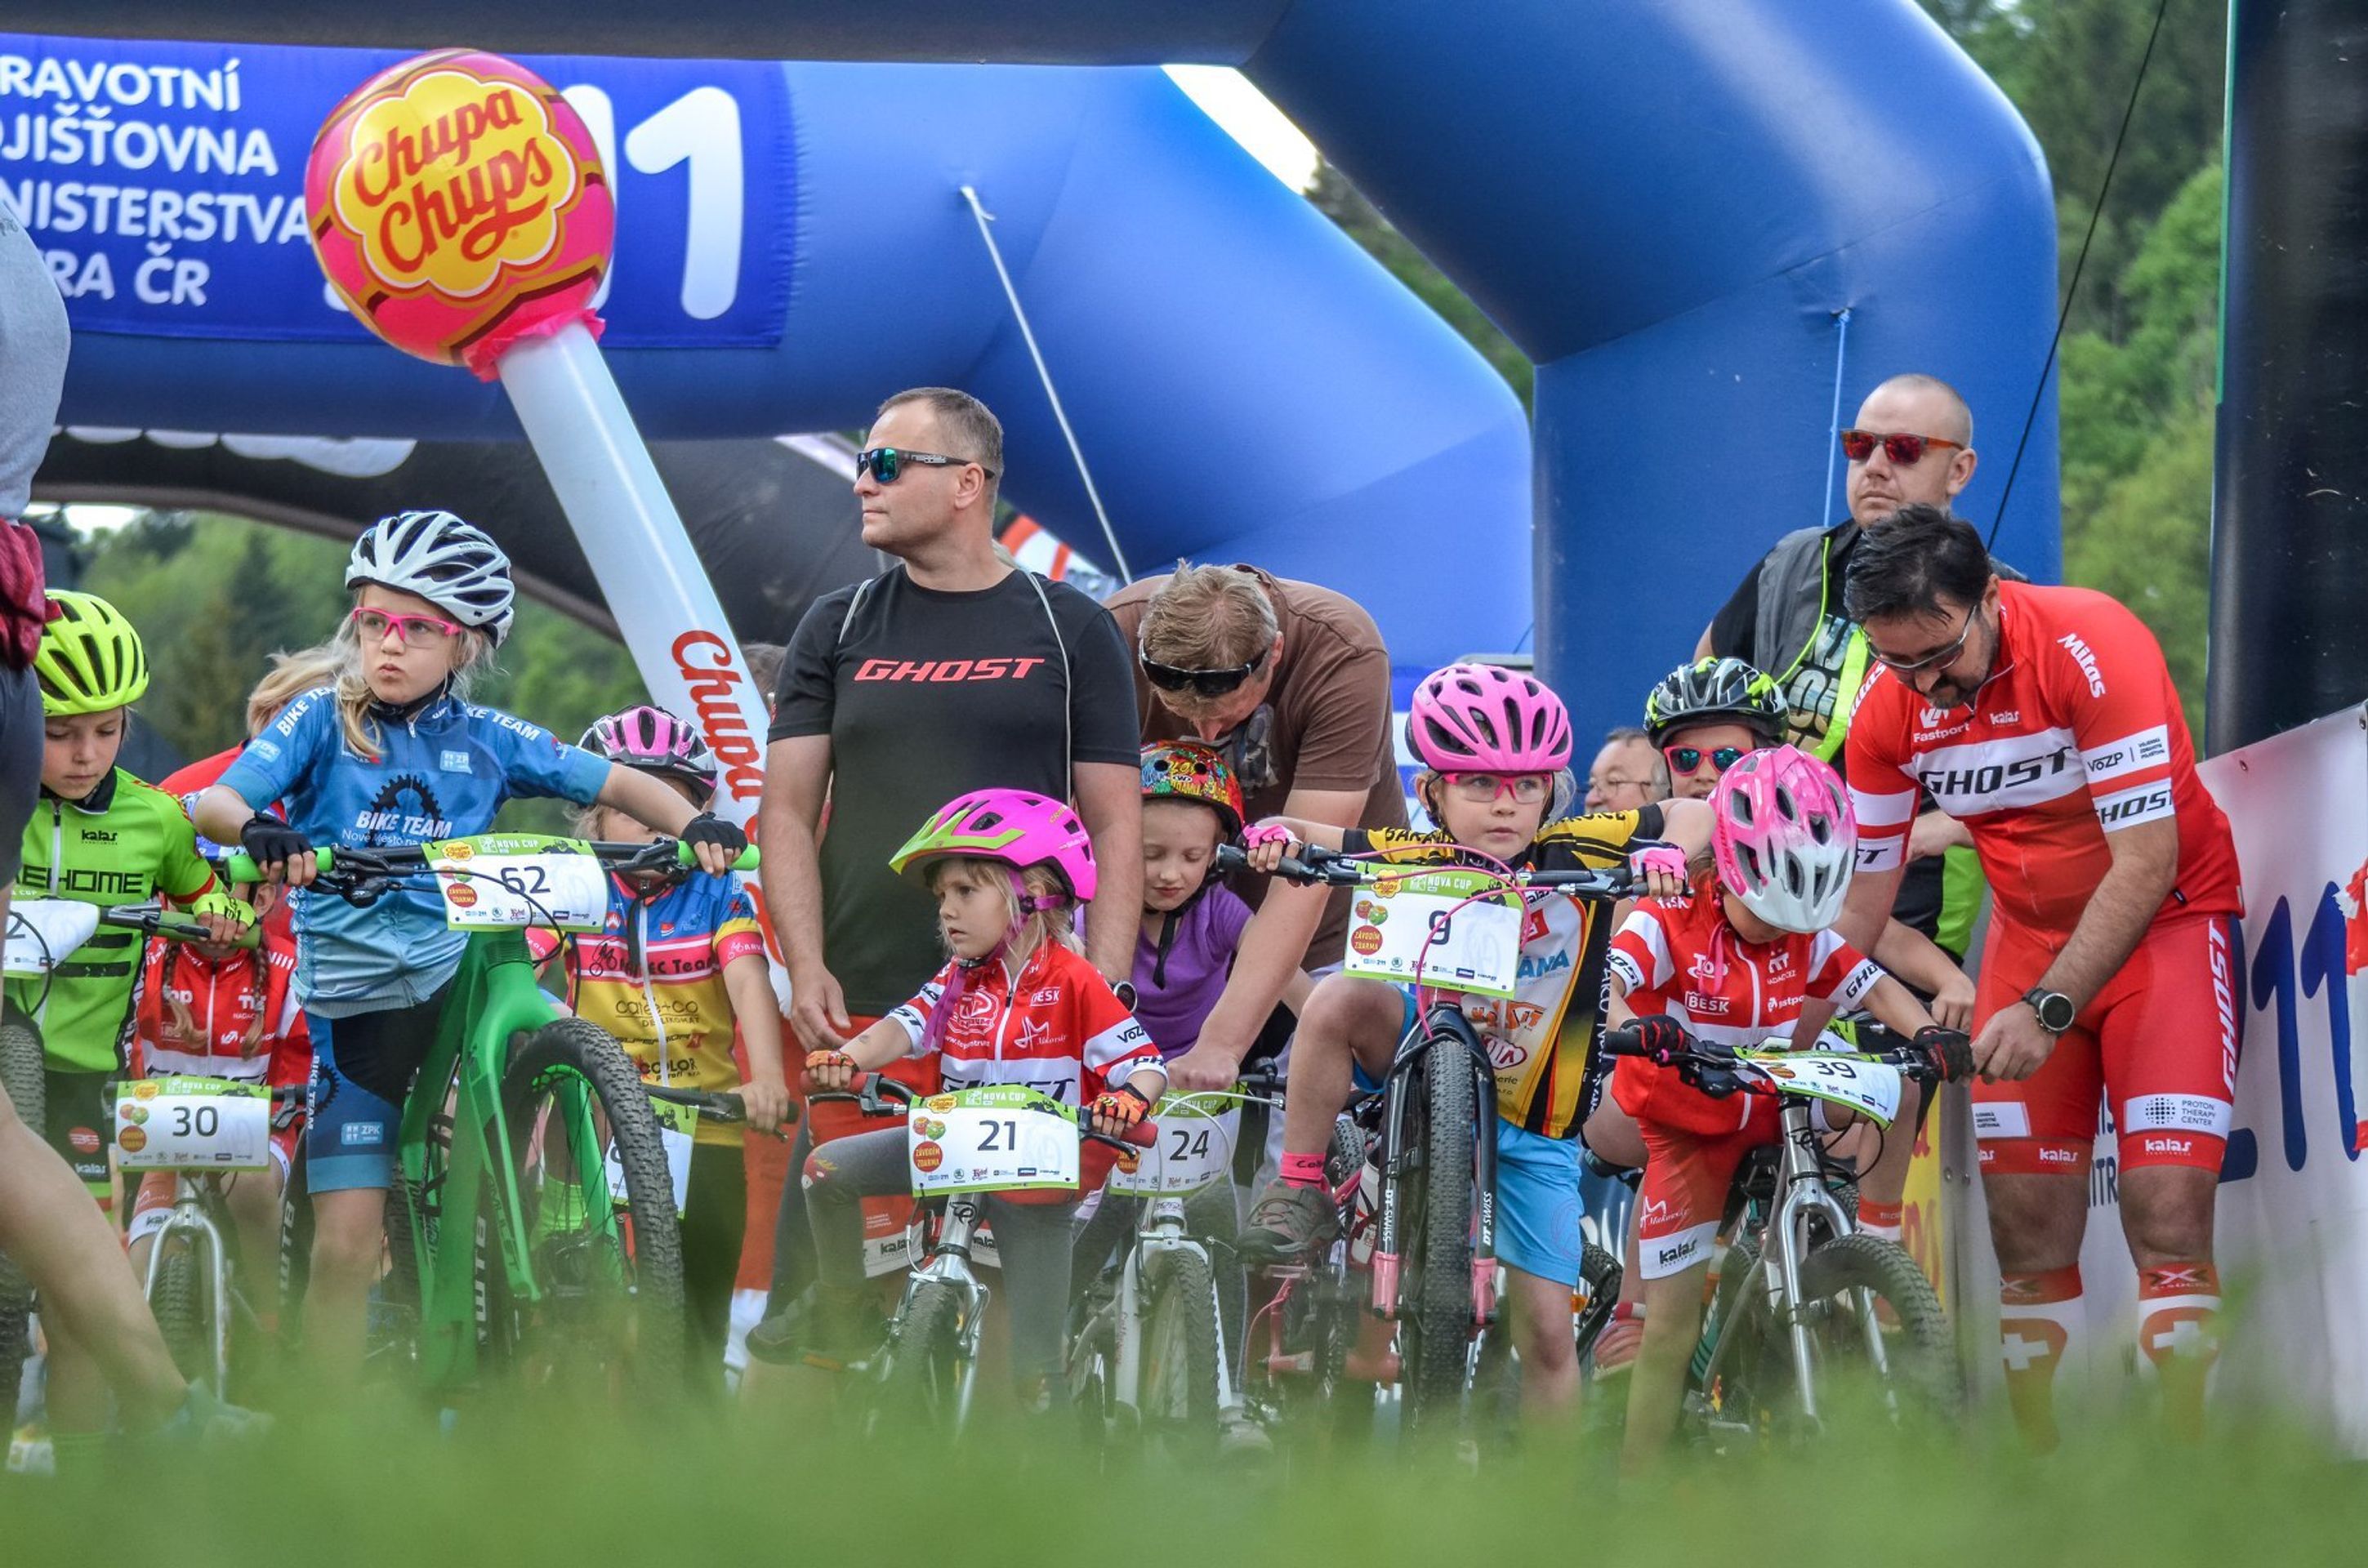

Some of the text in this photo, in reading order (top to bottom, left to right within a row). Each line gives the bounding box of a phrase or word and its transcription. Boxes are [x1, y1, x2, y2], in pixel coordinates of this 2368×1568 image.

[0, 102, 279, 176] JIŠŤOVNA
[354, 88, 524, 207] Chupa
[379, 137, 554, 274] Chups
[133, 240, 211, 307] ČR
[854, 657, 1046, 683] GHOST
[2057, 633, 2107, 699] Mitas
[275, 700, 310, 738] BIKE
[492, 710, 542, 742] TEAM
[671, 630, 766, 804] Chupa
[1913, 722, 1970, 744] Fastport
[1919, 746, 2074, 796] GHOST
[2096, 789, 2172, 825] HOS
[81, 829, 118, 842] kalas
[342, 828, 371, 843] Nové
[356, 809, 453, 840] BIKE TEAM
[16, 864, 144, 894] EHOME
[500, 866, 551, 895] 62
[1428, 876, 1472, 890] NOVA CUP
[1429, 909, 1452, 946] 9
[1688, 997, 1730, 1013] BESK
[2209, 918, 2236, 1098] GHOST
[2219, 881, 2360, 1183] 11
[1808, 1060, 1857, 1080] 39
[308, 1054, 321, 1131] BIKE TEAM
[983, 1090, 1027, 1102] NOVA CUP
[2182, 1099, 2215, 1111] PROTON
[172, 1105, 219, 1138] 30
[2181, 1116, 2213, 1127] CENTER
[2182, 1108, 2216, 1120] THERAPY
[977, 1119, 1016, 1152] 21
[1169, 1129, 1210, 1161] 24
[2145, 1138, 2192, 1152] kalas
[2039, 1147, 2079, 1163] kalas
[1383, 1209, 1395, 1242] SWISS
[1483, 1191, 1493, 1247] DT SWISS
[1659, 1238, 1698, 1265] kalas
